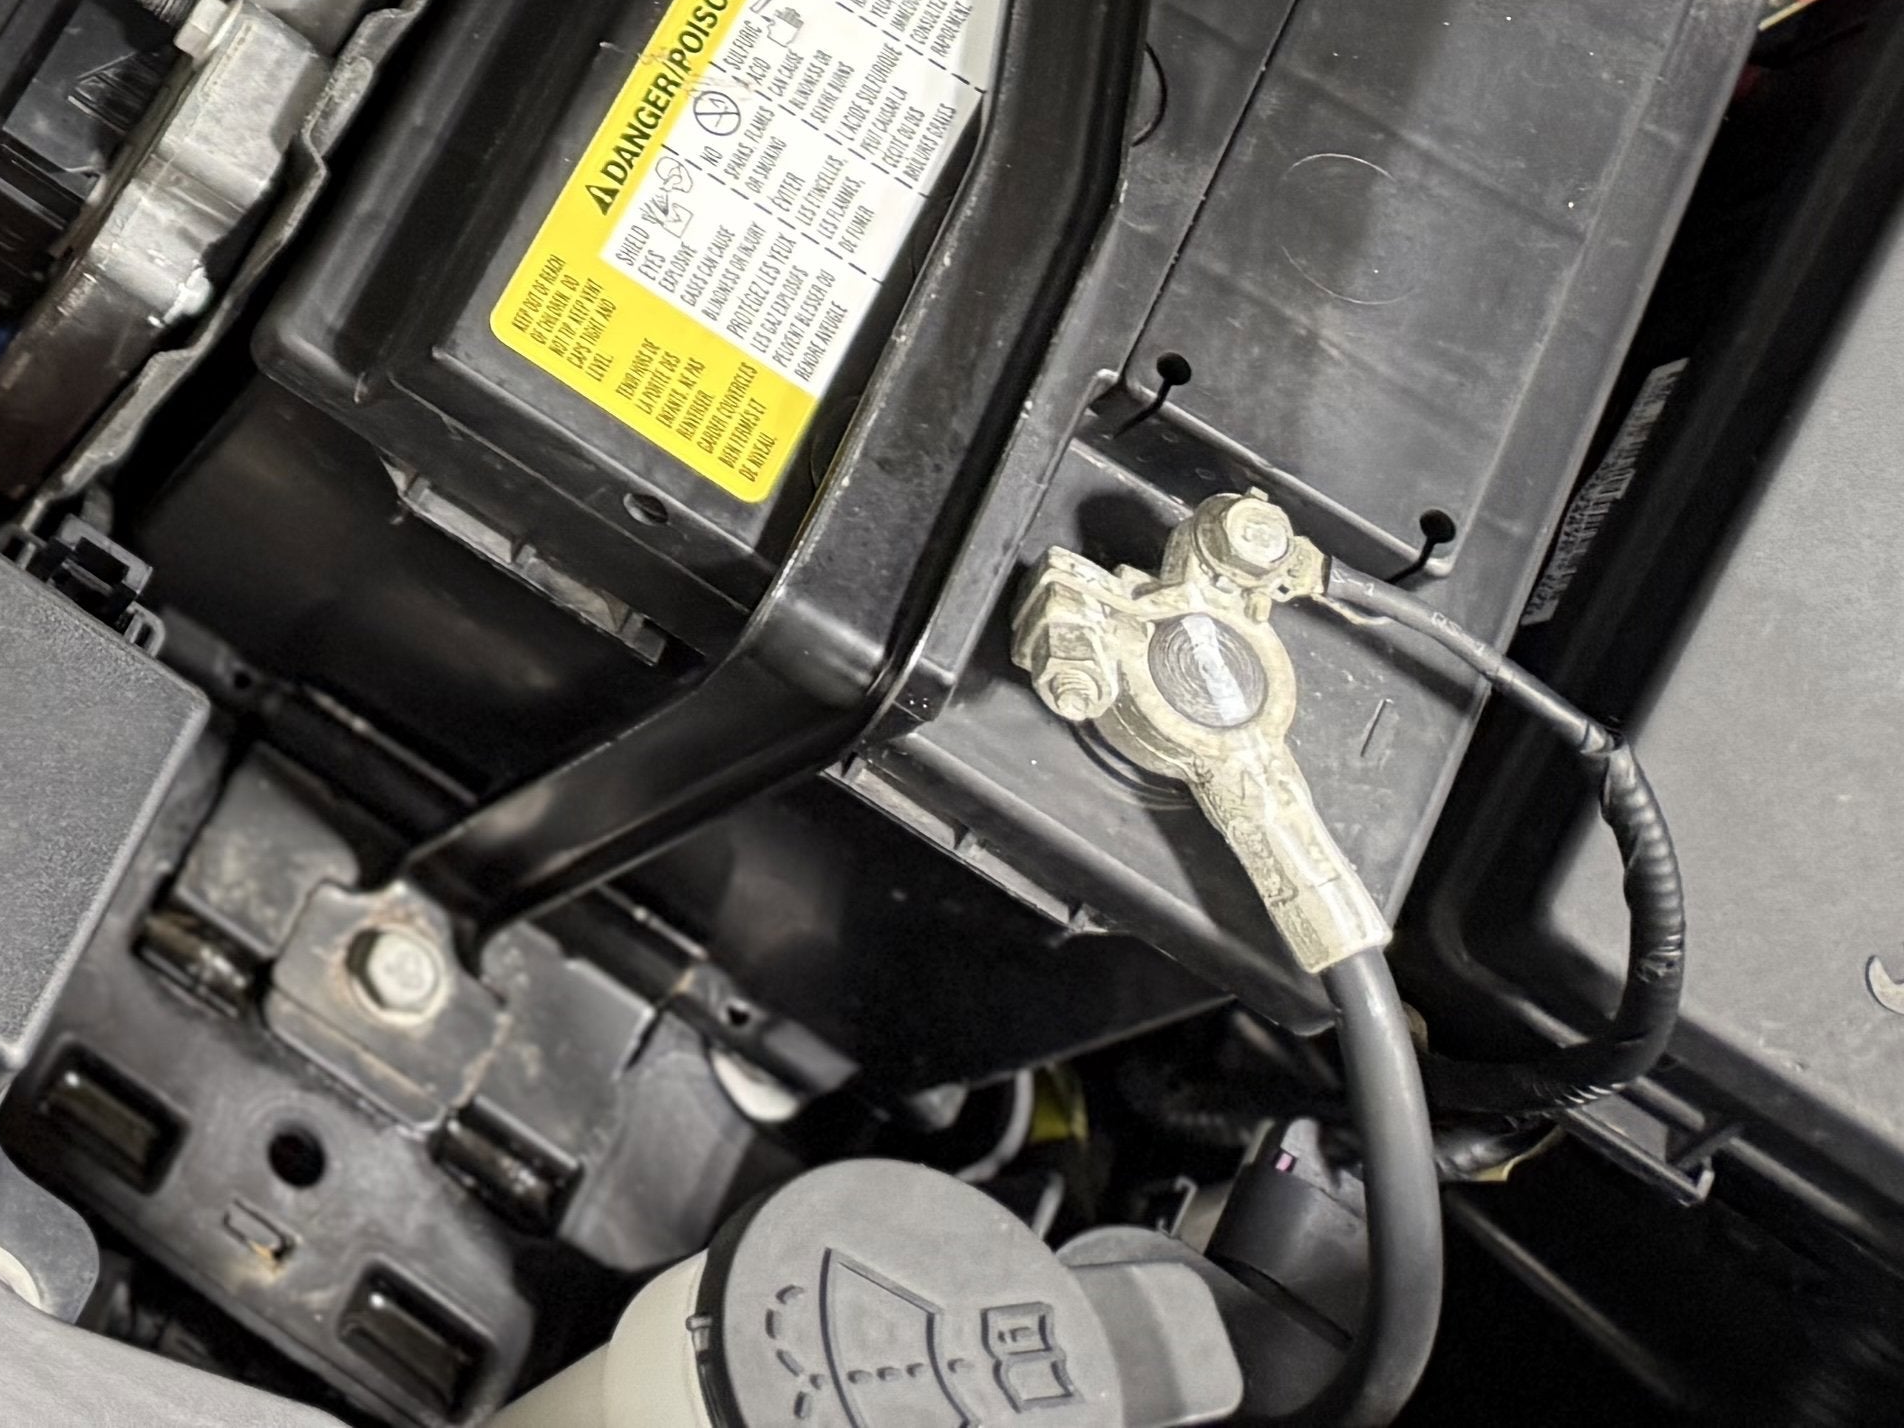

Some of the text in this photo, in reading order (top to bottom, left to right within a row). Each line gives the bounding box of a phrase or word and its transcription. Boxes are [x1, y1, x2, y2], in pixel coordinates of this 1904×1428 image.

[720, 18, 764, 72] SULFURIC
[742, 54, 772, 86] ACID
[764, 47, 806, 99] CAN CAUSE
[785, 47, 834, 112] BLINDNESS OR
[807, 59, 856, 125] SEVERE BURNS
[853, 41, 905, 107] SULFURIQUE
[742, 103, 778, 145] FLAMES
[856, 82, 911, 156] PEUT LA
[892, 119, 918, 142] OU
[900, 103, 928, 129] DES
[919, 97, 959, 140] GRAVES
[697, 143, 725, 168] NO
[741, 134, 789, 195] OR SMOKING
[765, 168, 807, 214] ÉVITER
[792, 201, 819, 227] LES
[612, 222, 652, 268] SHIELD
[813, 215, 842, 242] LES
[835, 202, 877, 254] DE FUMER
[576, 276, 605, 306] VENT
[635, 247, 668, 282] EYES
[655, 239, 699, 294] EXPLOSIVE
[676, 223, 737, 308] GASES CAN CAUSE
[698, 220, 769, 322] BLINDNESS OR INJURY
[720, 229, 799, 340] PROTÉGEZ LES YEUX
[509, 252, 568, 334] KEEP OUT OF REACH
[527, 326, 551, 346] OF
[558, 272, 582, 293] DO
[564, 297, 593, 327] KEEP
[746, 263, 812, 355] LES GAZ EXPLOSIFS
[767, 266, 839, 369] PEUVENT BLESSER OU
[546, 333, 572, 358] NOT
[564, 295, 619, 371] CAPS TIGHT AND
[790, 299, 850, 382] RENDRE AVEUGLE
[583, 347, 616, 383] LEVEL.
[613, 336, 663, 402] TENIR HORS DE
[631, 395, 656, 416] LA
[655, 348, 683, 374] DES
[675, 371, 699, 392] NE
[681, 355, 708, 380] PAS
[693, 360, 760, 455] GARDER COUVERCLES
[712, 439, 744, 469] BIEN
[743, 394, 769, 416] ET
[735, 461, 760, 483] DE
